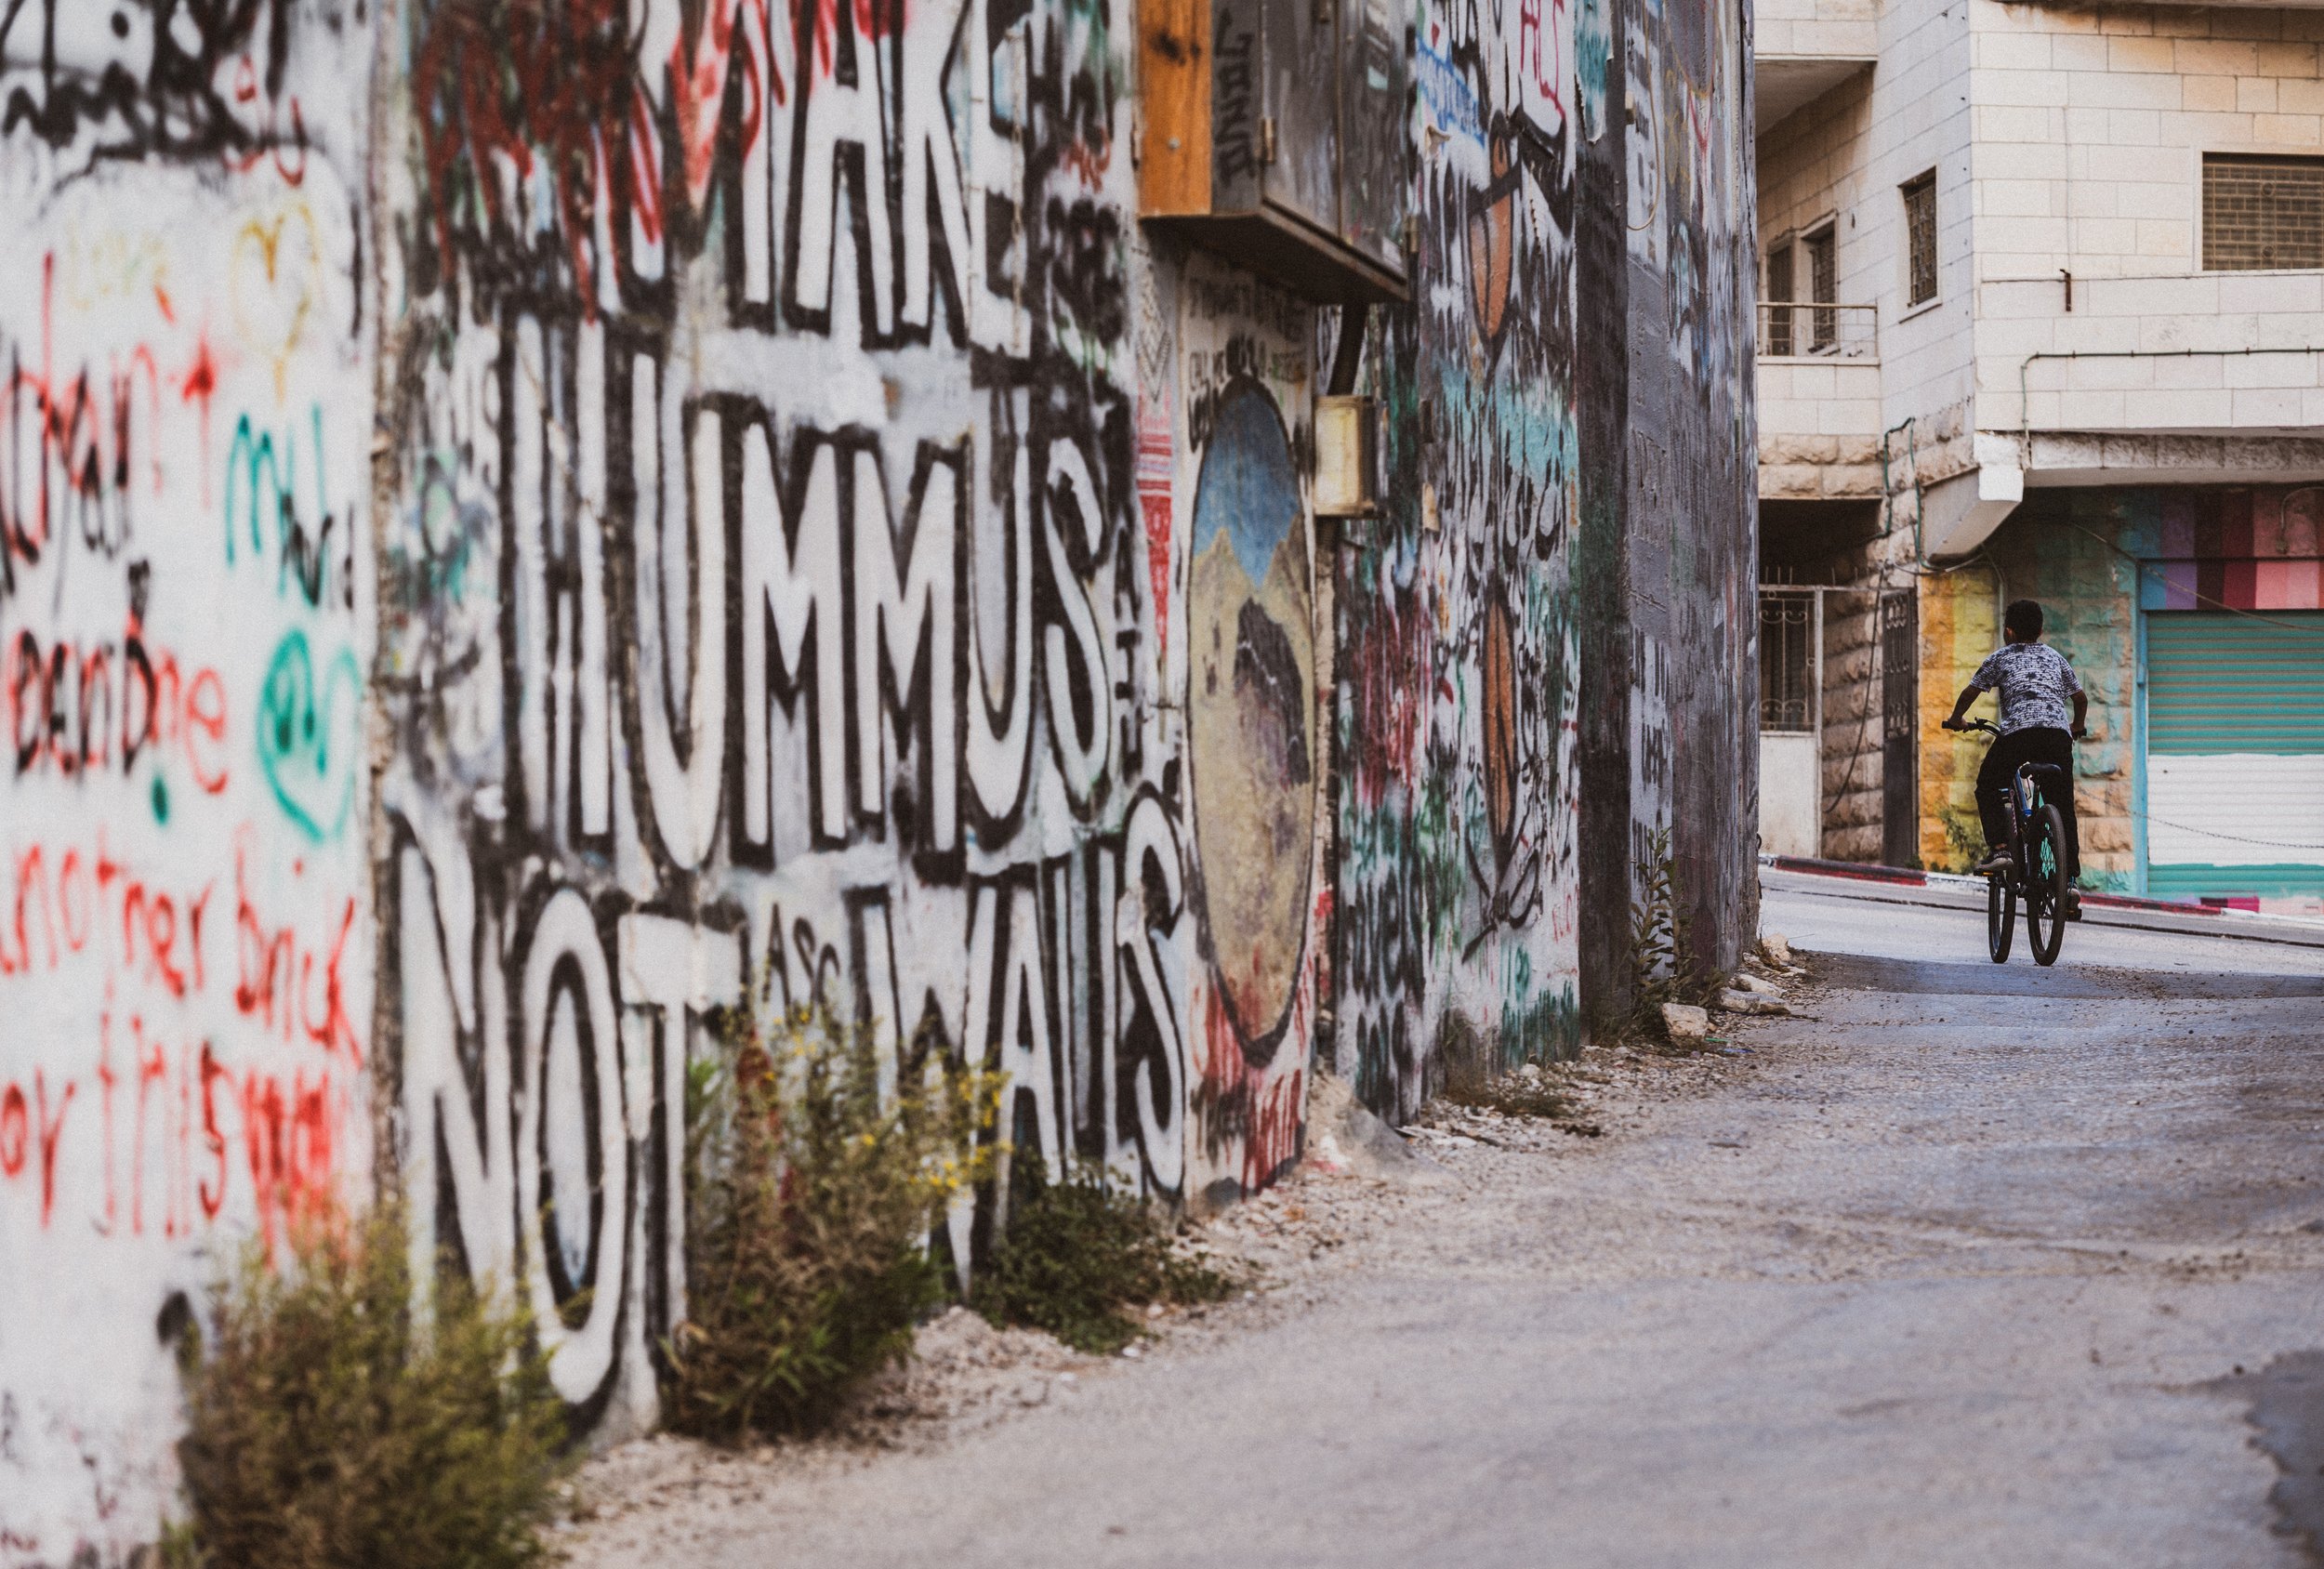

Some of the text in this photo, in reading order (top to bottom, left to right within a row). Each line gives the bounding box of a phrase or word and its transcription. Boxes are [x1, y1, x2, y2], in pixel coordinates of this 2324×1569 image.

[502, 309, 1116, 876] HUMMUS
[392, 825, 744, 1405] NOT
[852, 794, 1189, 1301] WALLS
